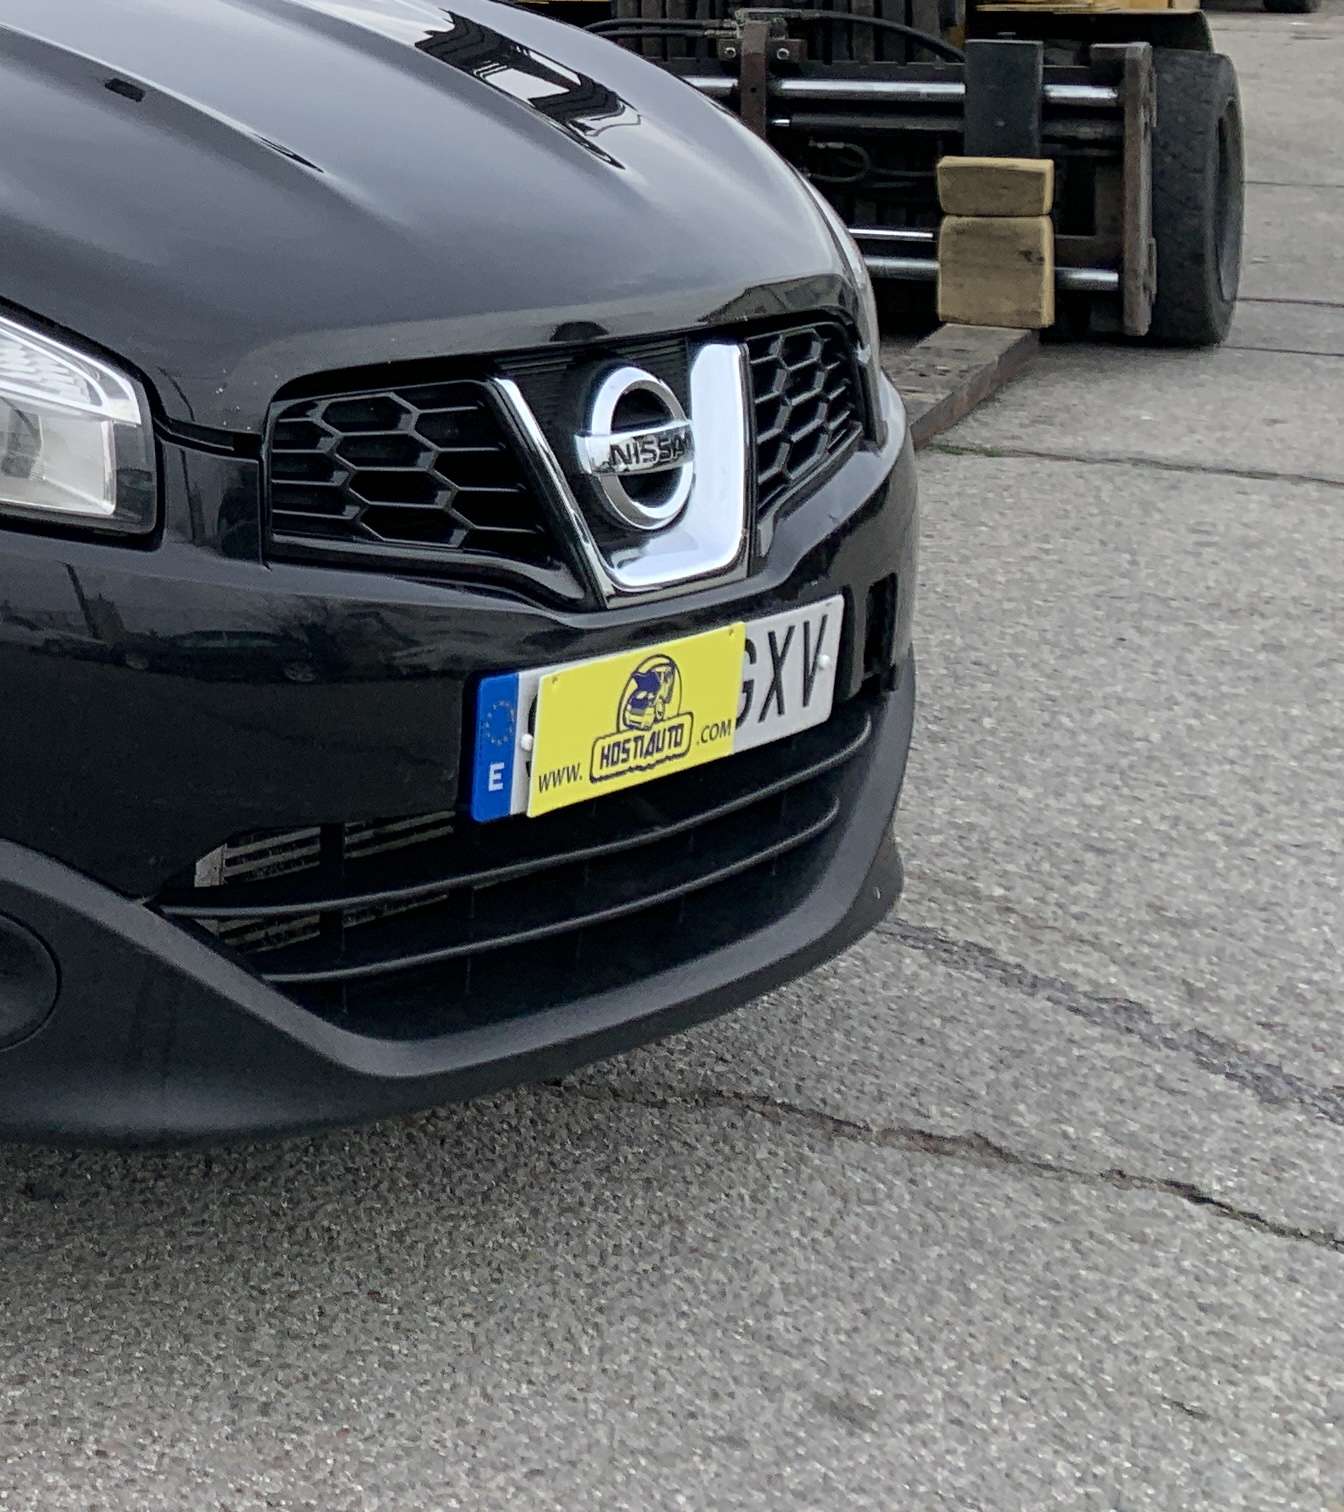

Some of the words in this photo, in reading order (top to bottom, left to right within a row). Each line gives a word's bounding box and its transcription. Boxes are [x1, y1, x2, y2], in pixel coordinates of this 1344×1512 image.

[488, 762, 505, 792] E
[538, 763, 583, 793] WWW.
[599, 723, 685, 770] HOSTIAUTO
